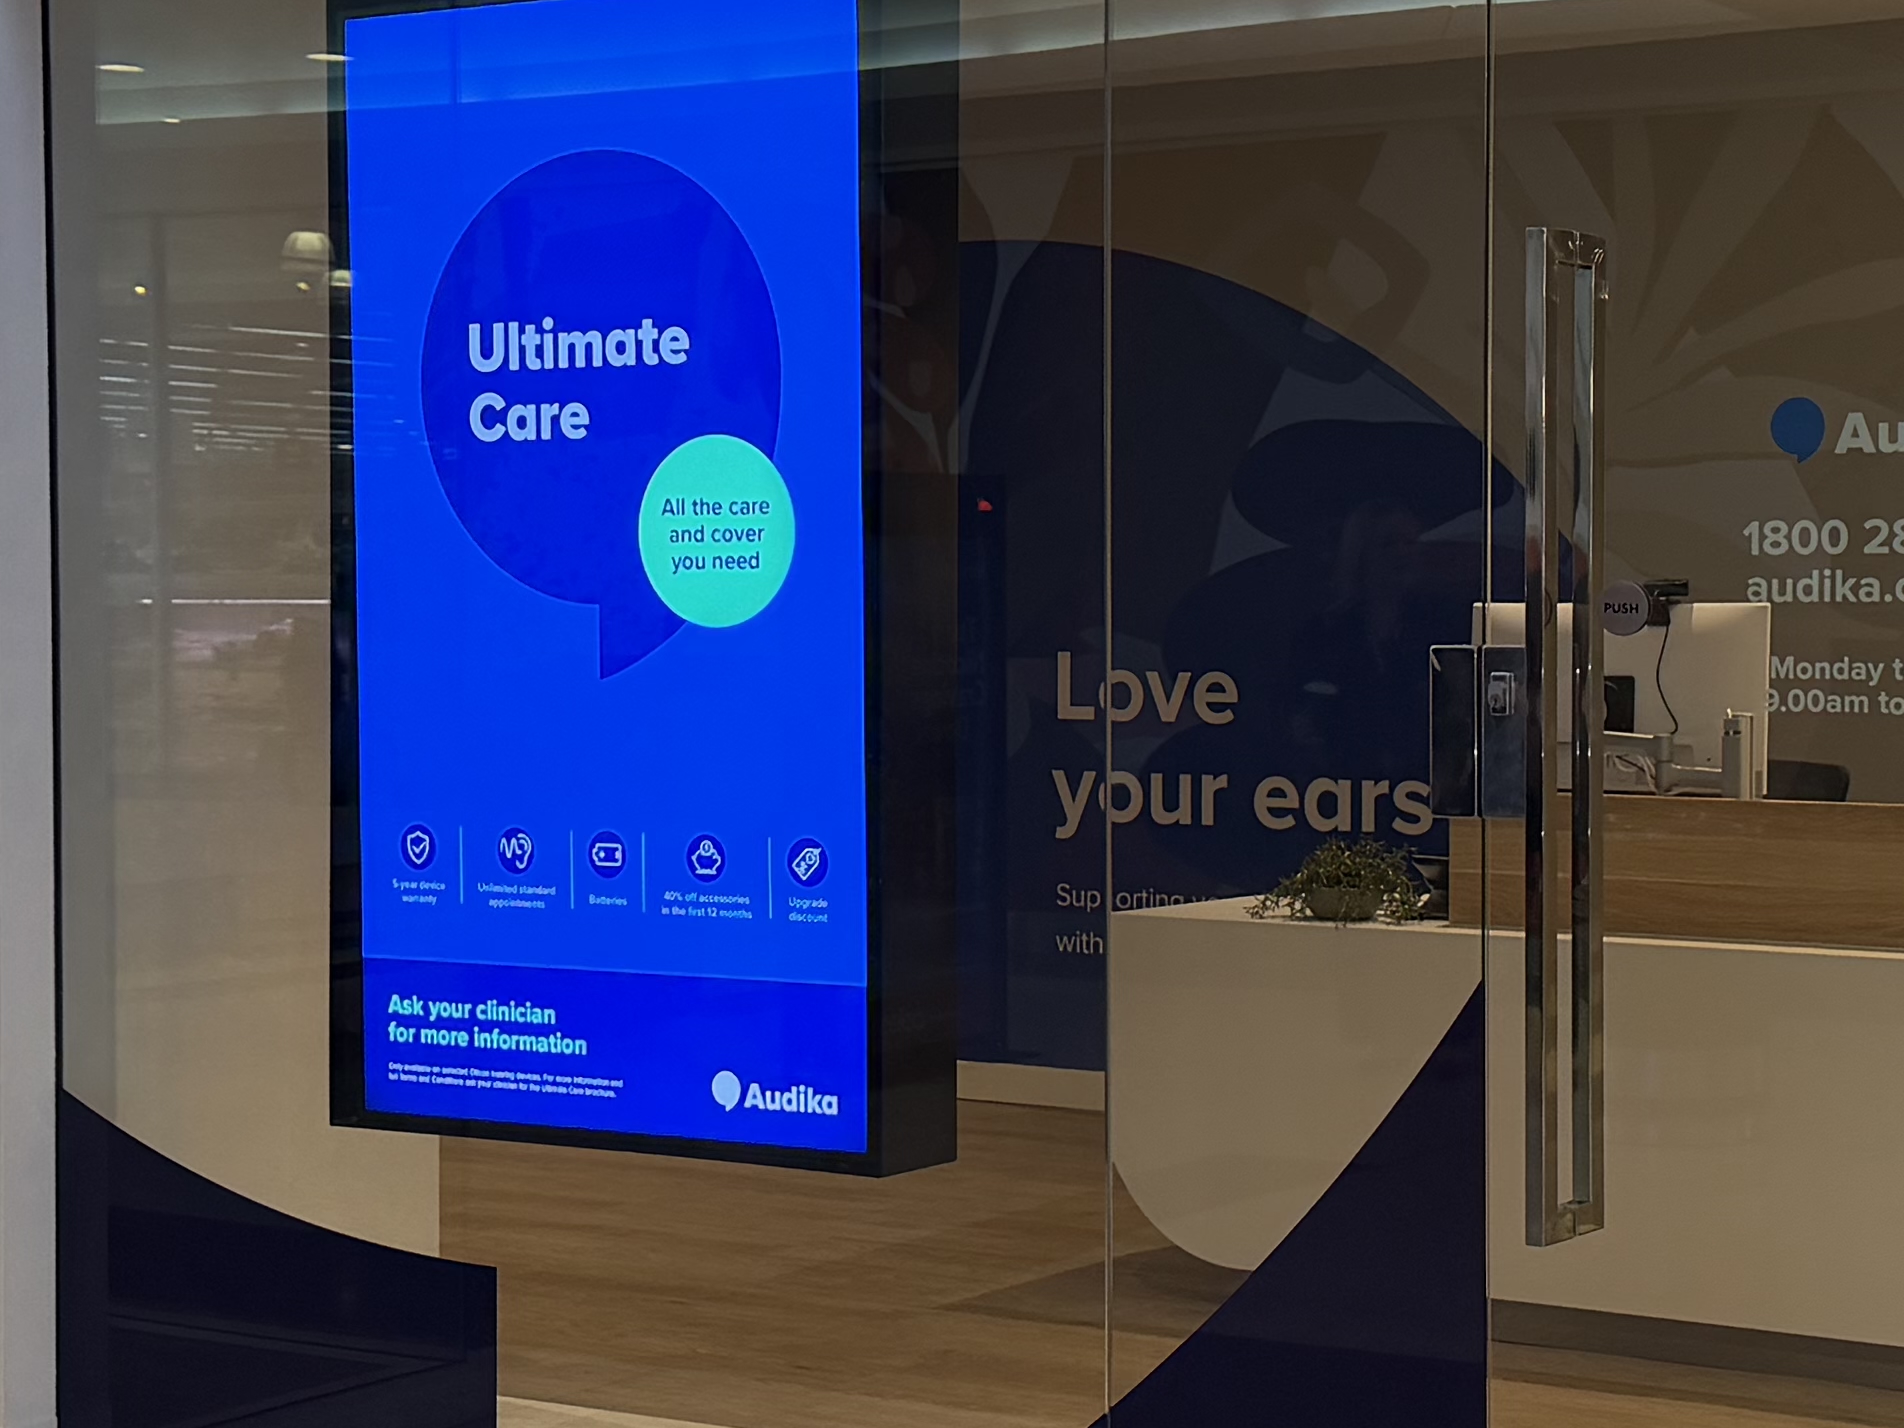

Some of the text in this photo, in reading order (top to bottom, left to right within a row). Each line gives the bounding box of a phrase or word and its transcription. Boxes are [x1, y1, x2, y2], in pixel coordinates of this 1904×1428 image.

[469, 316, 690, 372] Ultimate
[469, 392, 590, 442] Care
[661, 498, 770, 516] All the care
[669, 524, 765, 543] and cover
[1743, 518, 1849, 556] 1800
[671, 551, 760, 575] you need
[1604, 602, 1639, 614] PUSH
[1770, 656, 1885, 686] Monday
[1056, 651, 1239, 725] Love
[1766, 689, 1869, 713] 9.00am
[1051, 768, 1434, 839] your ears
[1056, 931, 1104, 955] with
[387, 994, 556, 1025] Ask your clinician
[387, 1021, 588, 1056] for more information
[744, 1083, 838, 1115] Audika
